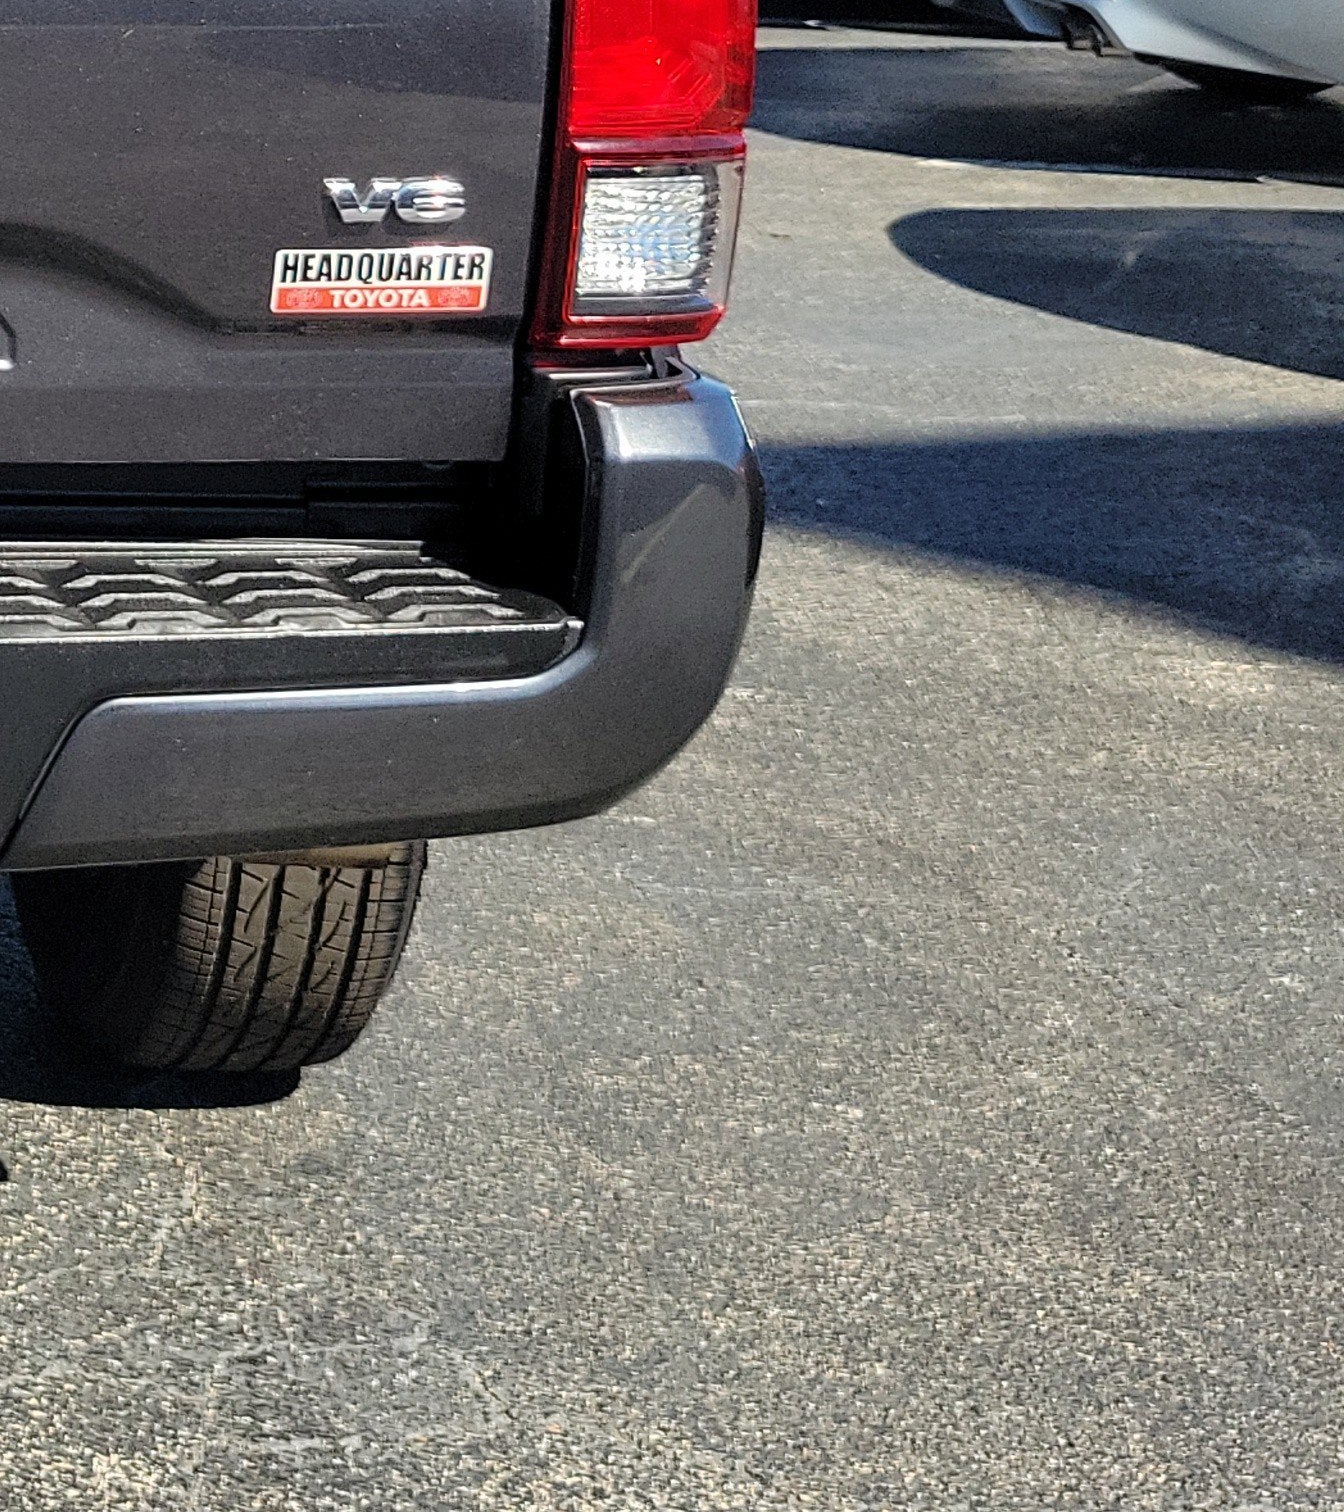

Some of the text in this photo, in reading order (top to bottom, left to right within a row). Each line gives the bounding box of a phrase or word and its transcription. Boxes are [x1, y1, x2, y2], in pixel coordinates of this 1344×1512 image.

[323, 177, 467, 224] V6
[279, 252, 486, 285] HEADQUARTER
[329, 288, 430, 308] TOYOTA
